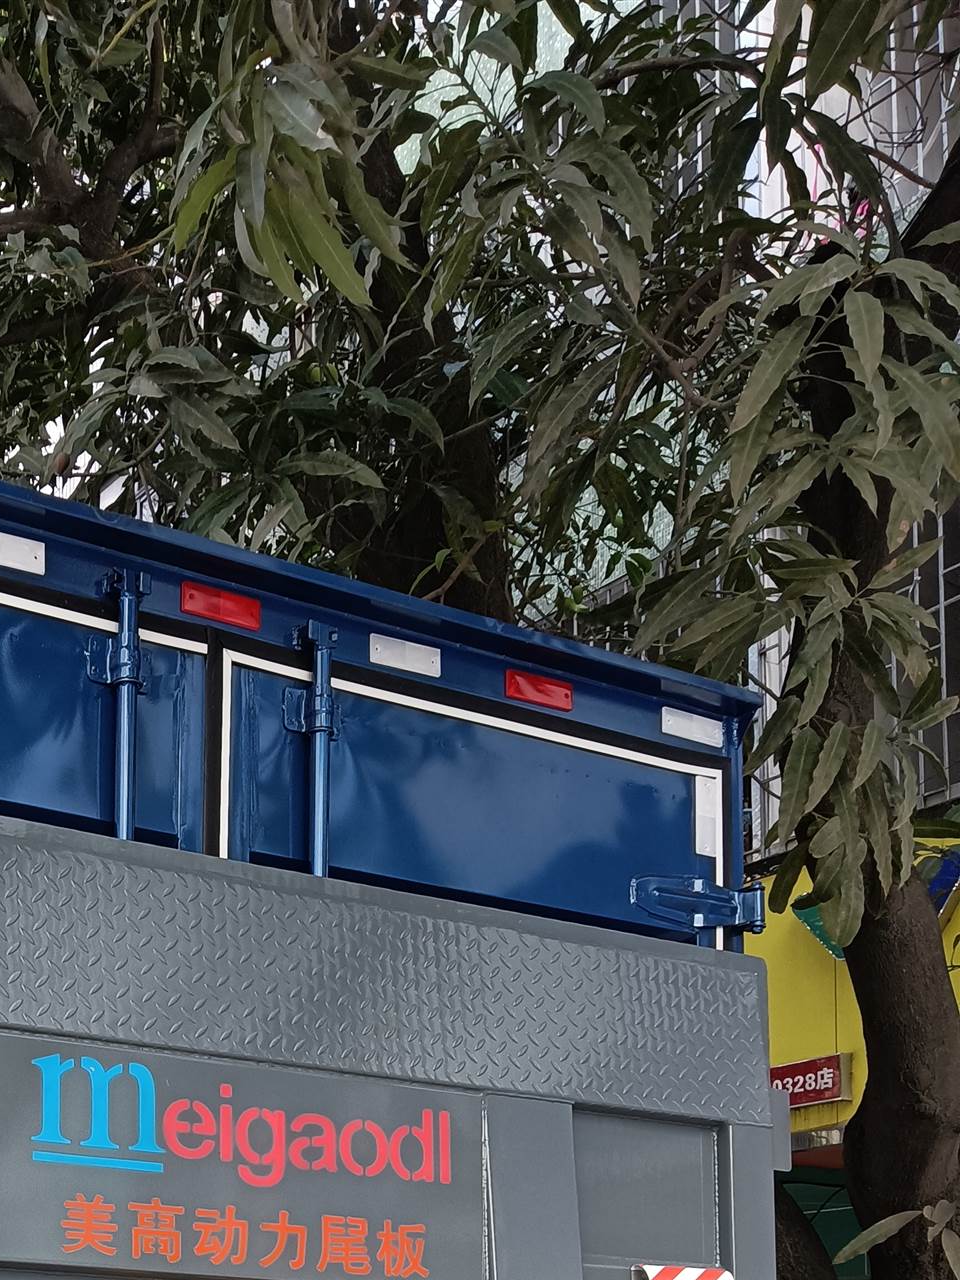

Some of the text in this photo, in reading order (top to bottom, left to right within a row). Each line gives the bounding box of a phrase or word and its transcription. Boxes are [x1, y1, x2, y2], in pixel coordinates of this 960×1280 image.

[60, 1193, 430, 1279] 美高动力尾板
